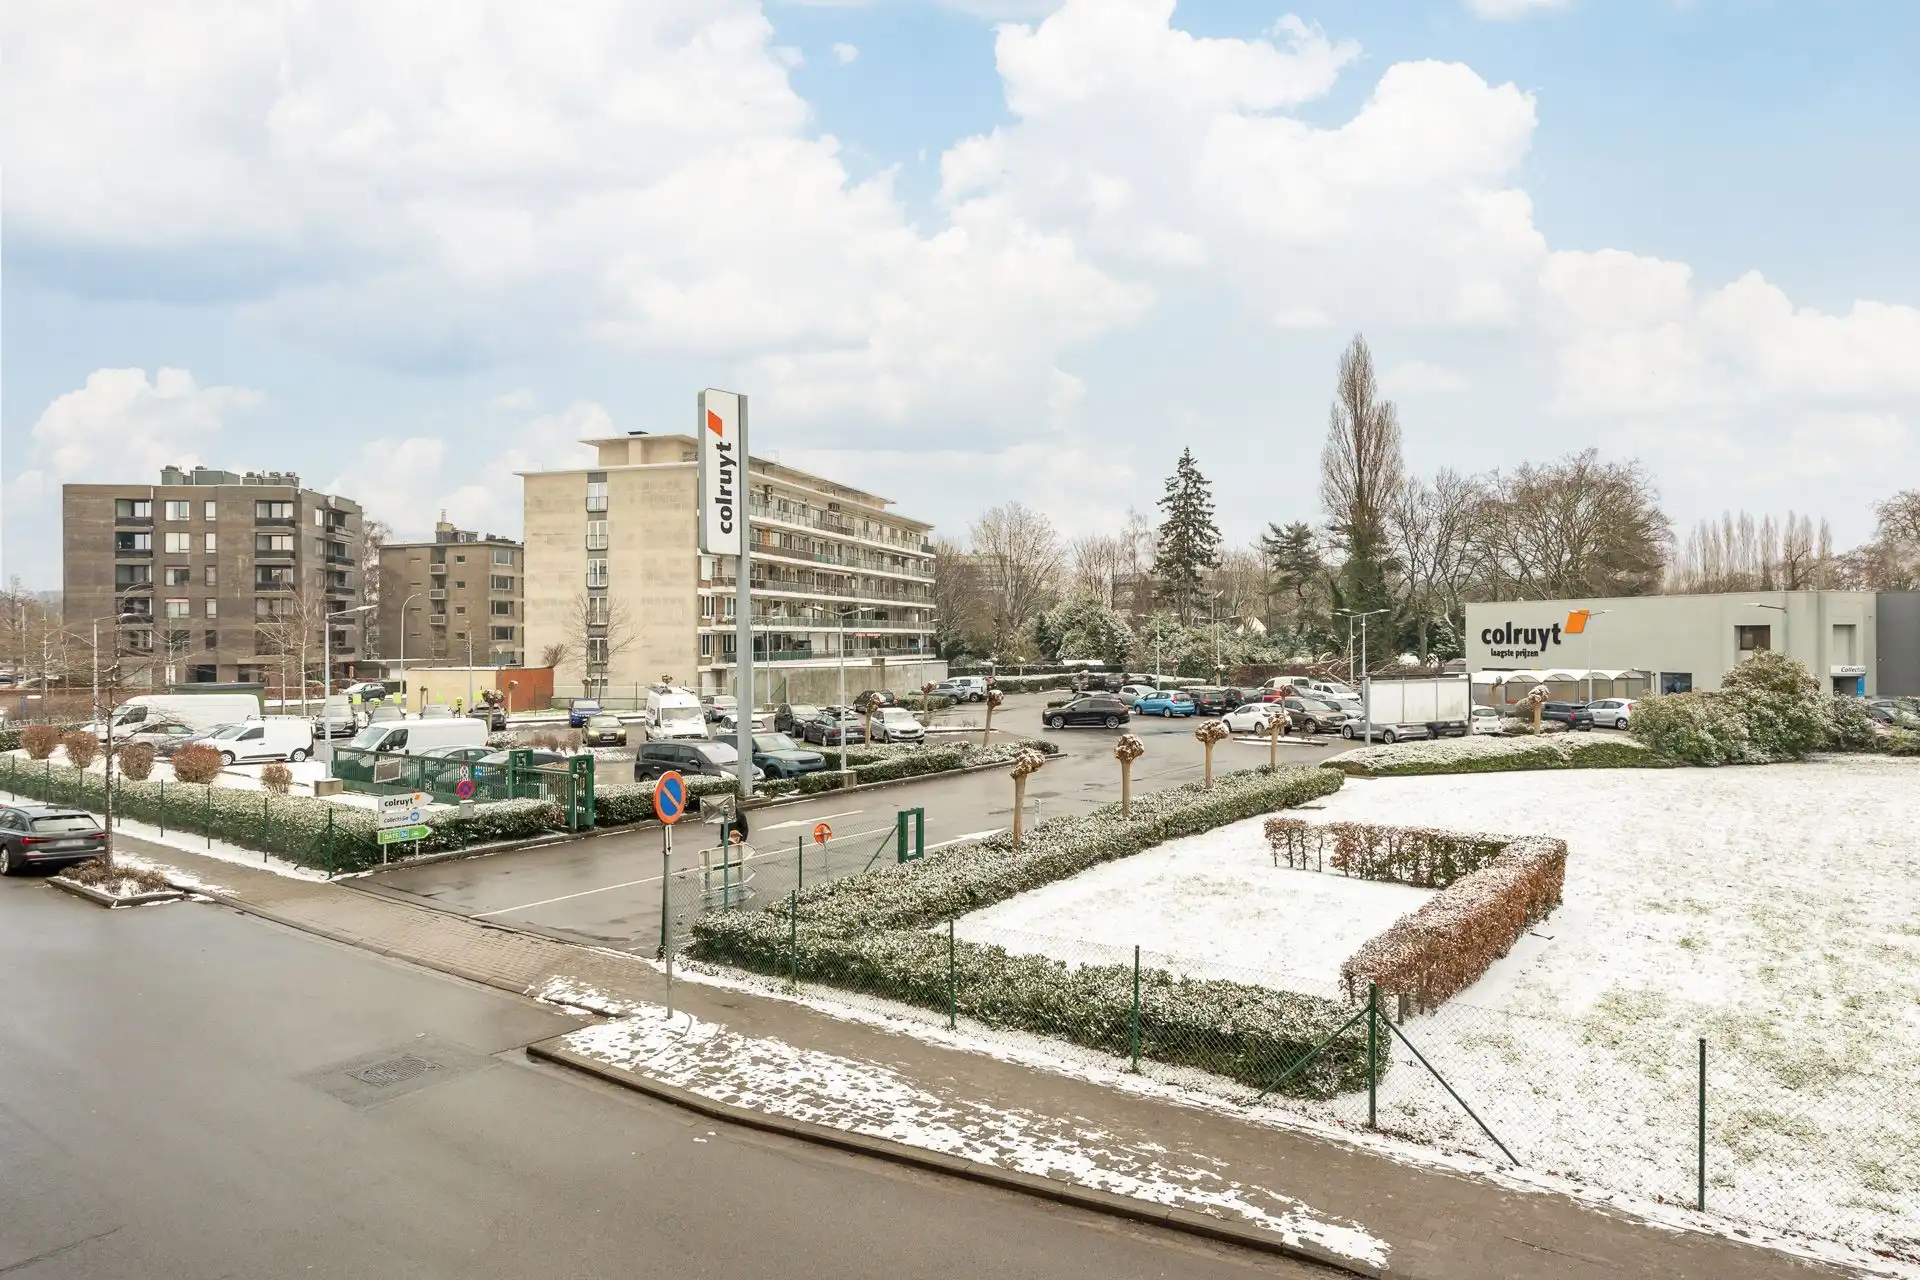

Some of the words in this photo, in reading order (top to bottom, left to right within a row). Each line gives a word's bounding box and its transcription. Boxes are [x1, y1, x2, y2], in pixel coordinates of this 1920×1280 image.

[715, 441, 737, 534] colruyt
[1481, 621, 1561, 652] colruyt
[1490, 648, 1514, 658] laagste
[1515, 648, 1539, 659] prijzen
[384, 797, 413, 807] colruyt
